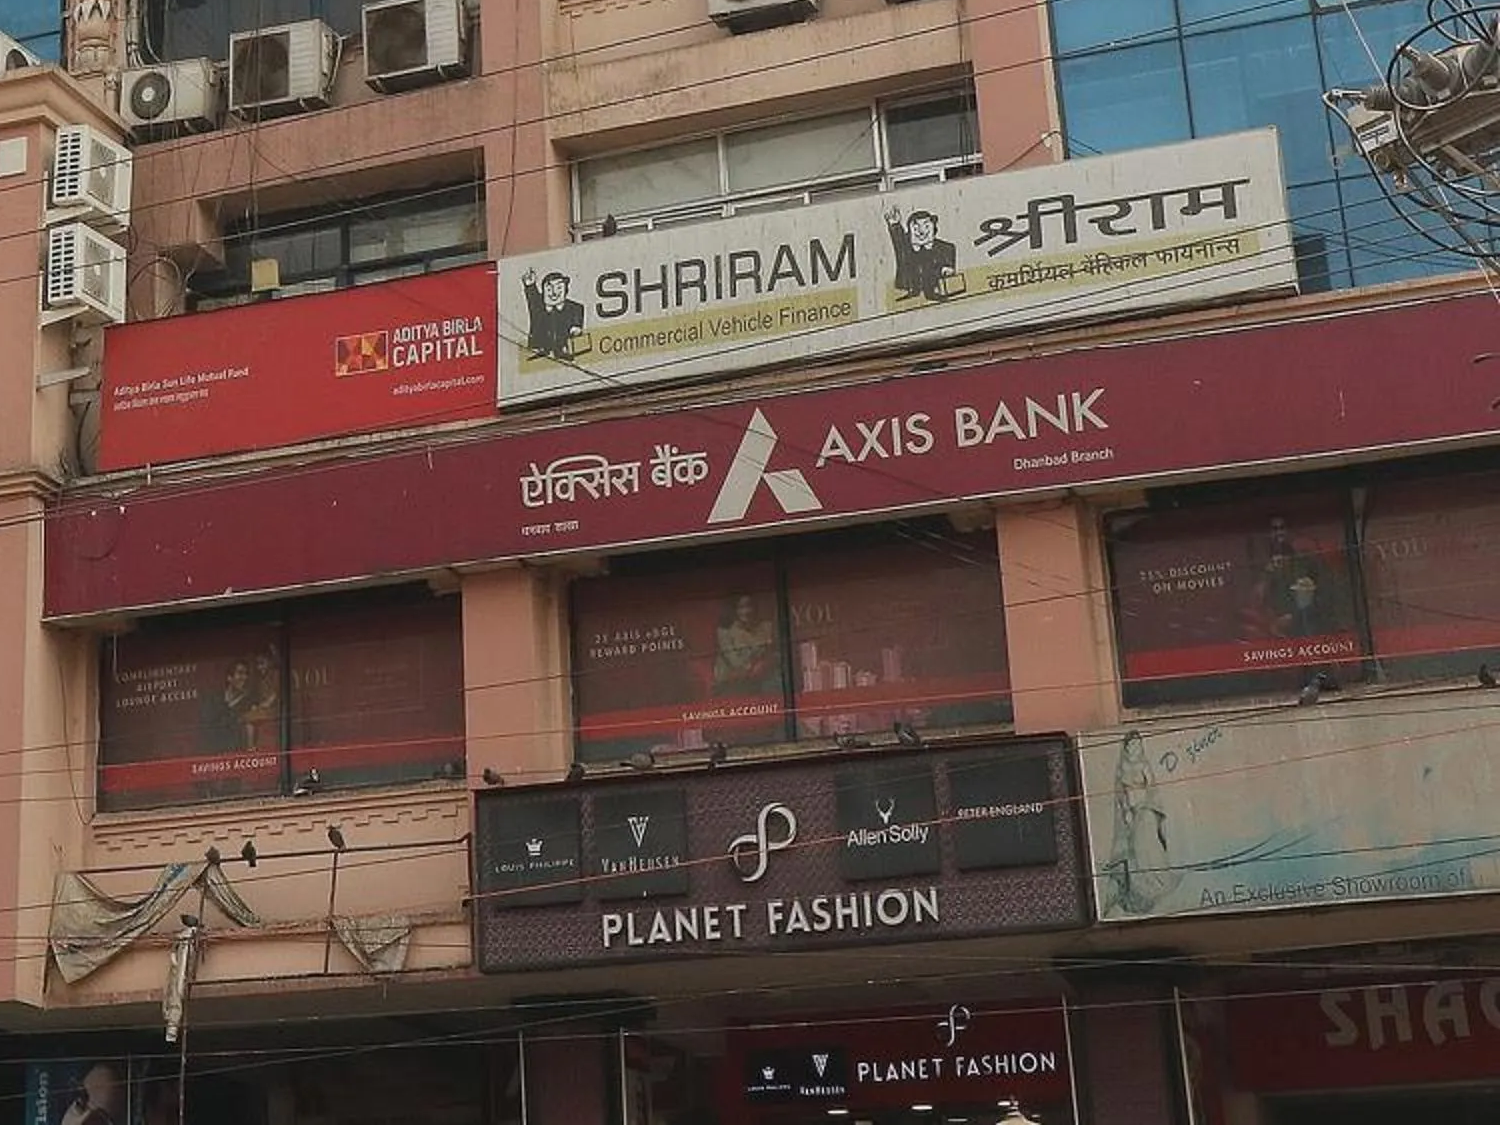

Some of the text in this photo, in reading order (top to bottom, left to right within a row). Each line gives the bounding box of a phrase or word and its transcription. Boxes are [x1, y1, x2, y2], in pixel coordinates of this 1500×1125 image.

[974, 177, 1250, 257] श्रीराम
[596, 233, 857, 318] SHRIRAM
[394, 316, 482, 343] ADITYA BIRLA
[599, 300, 851, 354] Commercial Vehicle Finance
[393, 335, 483, 367] CAPITAL
[816, 388, 1109, 468] AXIS BANK
[1014, 447, 1113, 470] Dhanbad Branch
[520, 443, 709, 507] ऐक्सिस बैंक
[1169, 561, 1232, 577] DISCOUNT
[1153, 577, 1225, 594] ON MOVIES
[1243, 641, 1353, 662] SAVINGS ACCOUNT
[730, 703, 778, 717] ACCOUNT
[233, 756, 277, 770] ACCOUNT
[1200, 887, 1225, 908] An
[1233, 881, 1325, 904] Exclusive
[1333, 874, 1438, 896] Showroom
[602, 887, 941, 948] PLANET FASHION
[858, 1051, 1056, 1083] PLANET FASHION
